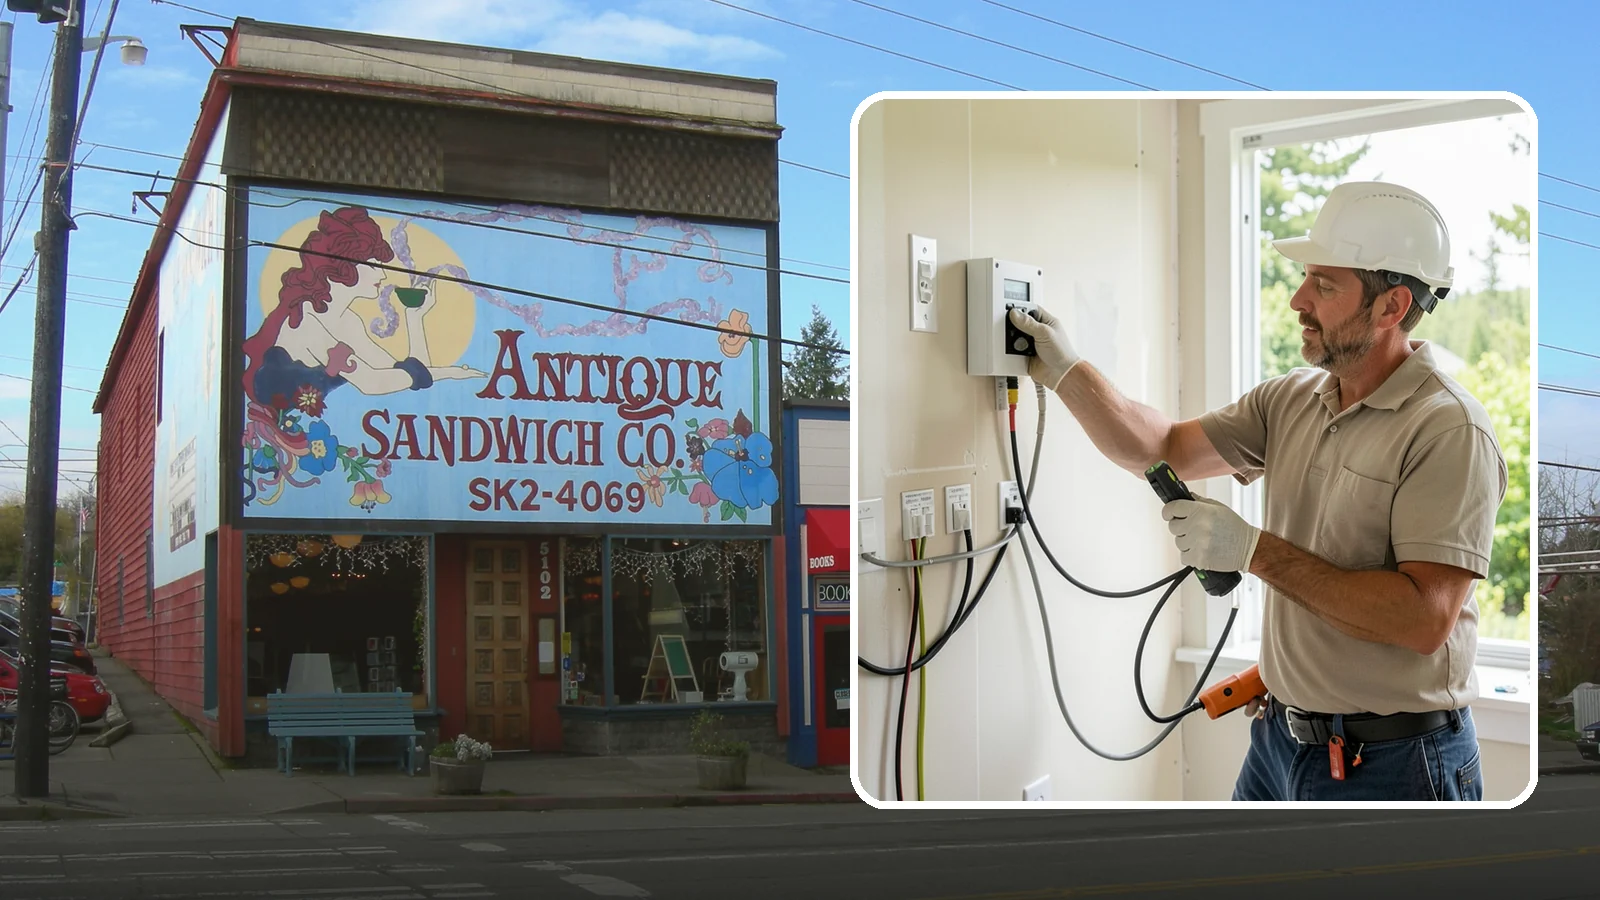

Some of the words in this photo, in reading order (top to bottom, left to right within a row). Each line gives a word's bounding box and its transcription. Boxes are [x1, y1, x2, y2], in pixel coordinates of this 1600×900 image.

[476, 329, 723, 420] ANTIQUE
[361, 409, 604, 467] SANDWICH
[617, 422, 685, 468] CO.
[469, 477, 645, 512] SK2-4069
[540, 542, 551, 599] 5102
[809, 555, 834, 568] BOOKS
